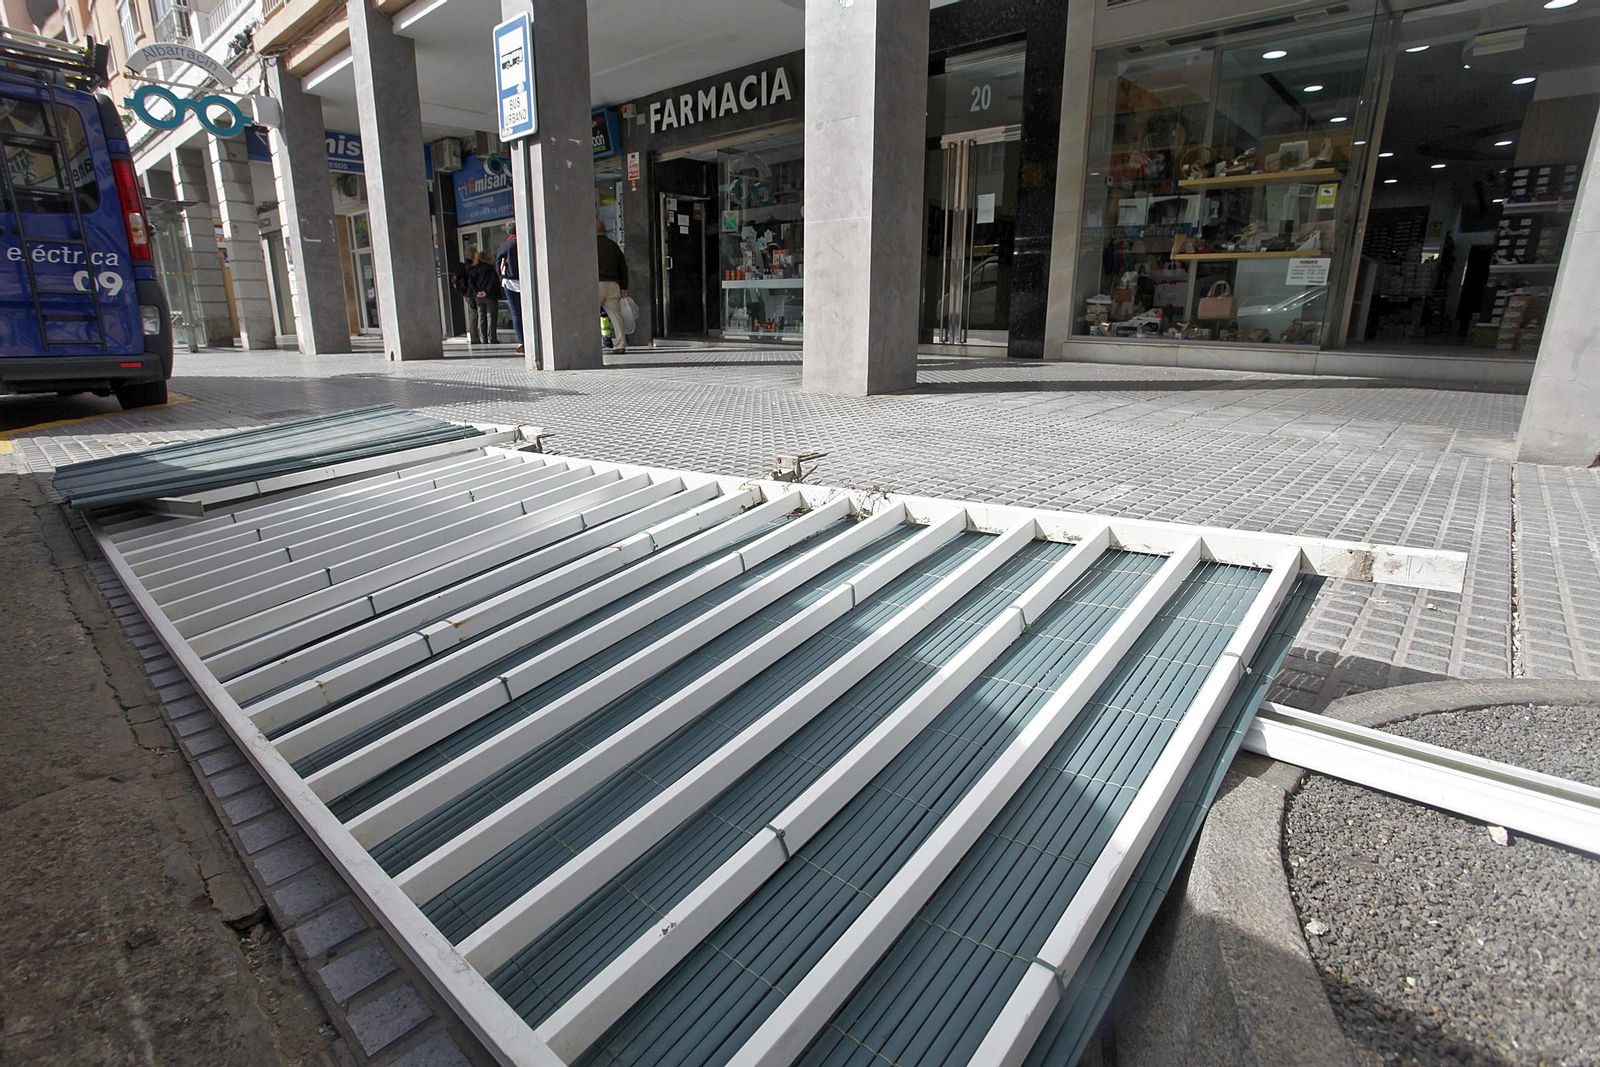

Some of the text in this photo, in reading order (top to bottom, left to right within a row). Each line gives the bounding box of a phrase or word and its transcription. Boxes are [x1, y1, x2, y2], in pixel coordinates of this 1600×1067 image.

[510, 97, 520, 110] BUS
[649, 66, 792, 134] FARMACIA
[970, 84, 992, 112] 20
[504, 108, 526, 125] URBANO
[469, 173, 506, 193] Emisan
[6, 244, 120, 266] eéctrca
[73, 271, 123, 296] 09
